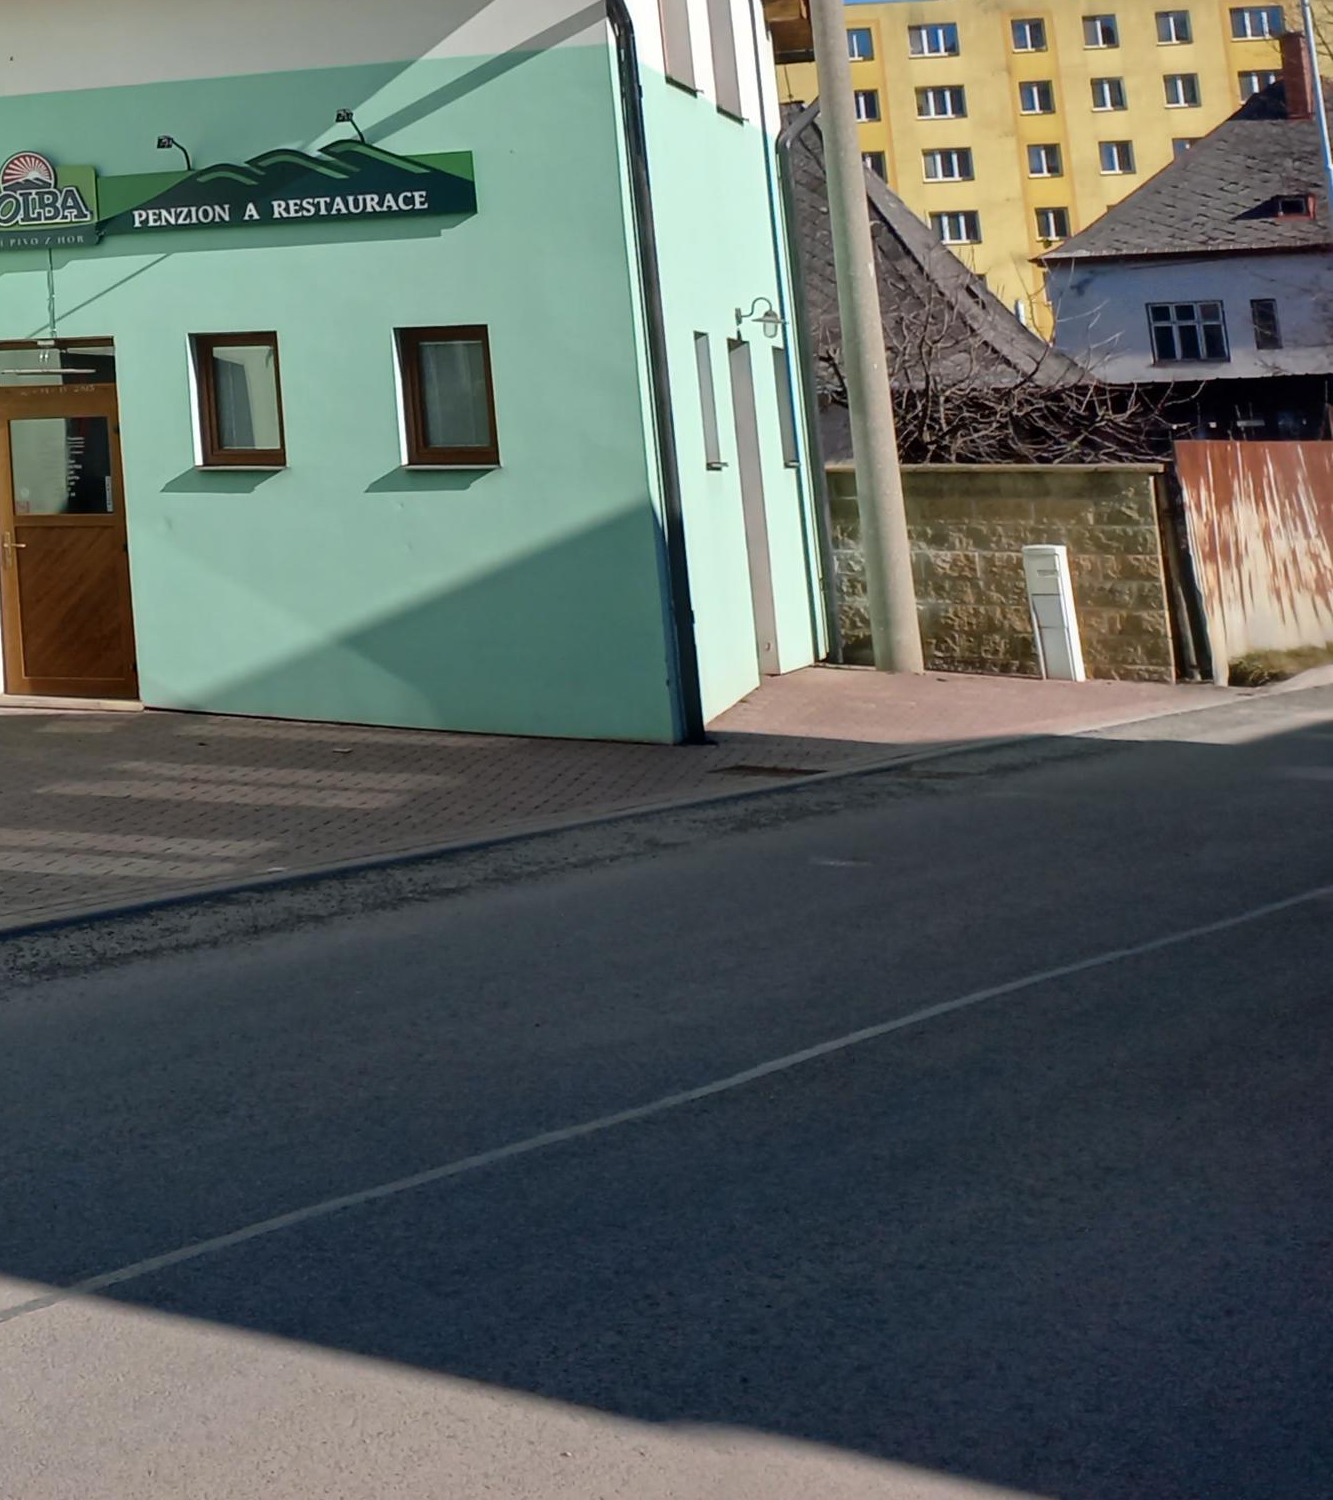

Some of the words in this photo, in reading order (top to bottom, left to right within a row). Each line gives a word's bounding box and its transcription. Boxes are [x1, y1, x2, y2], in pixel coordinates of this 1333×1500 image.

[132, 203, 231, 228] PENZION
[243, 202, 261, 221] A
[271, 190, 429, 219] RESTAURACE
